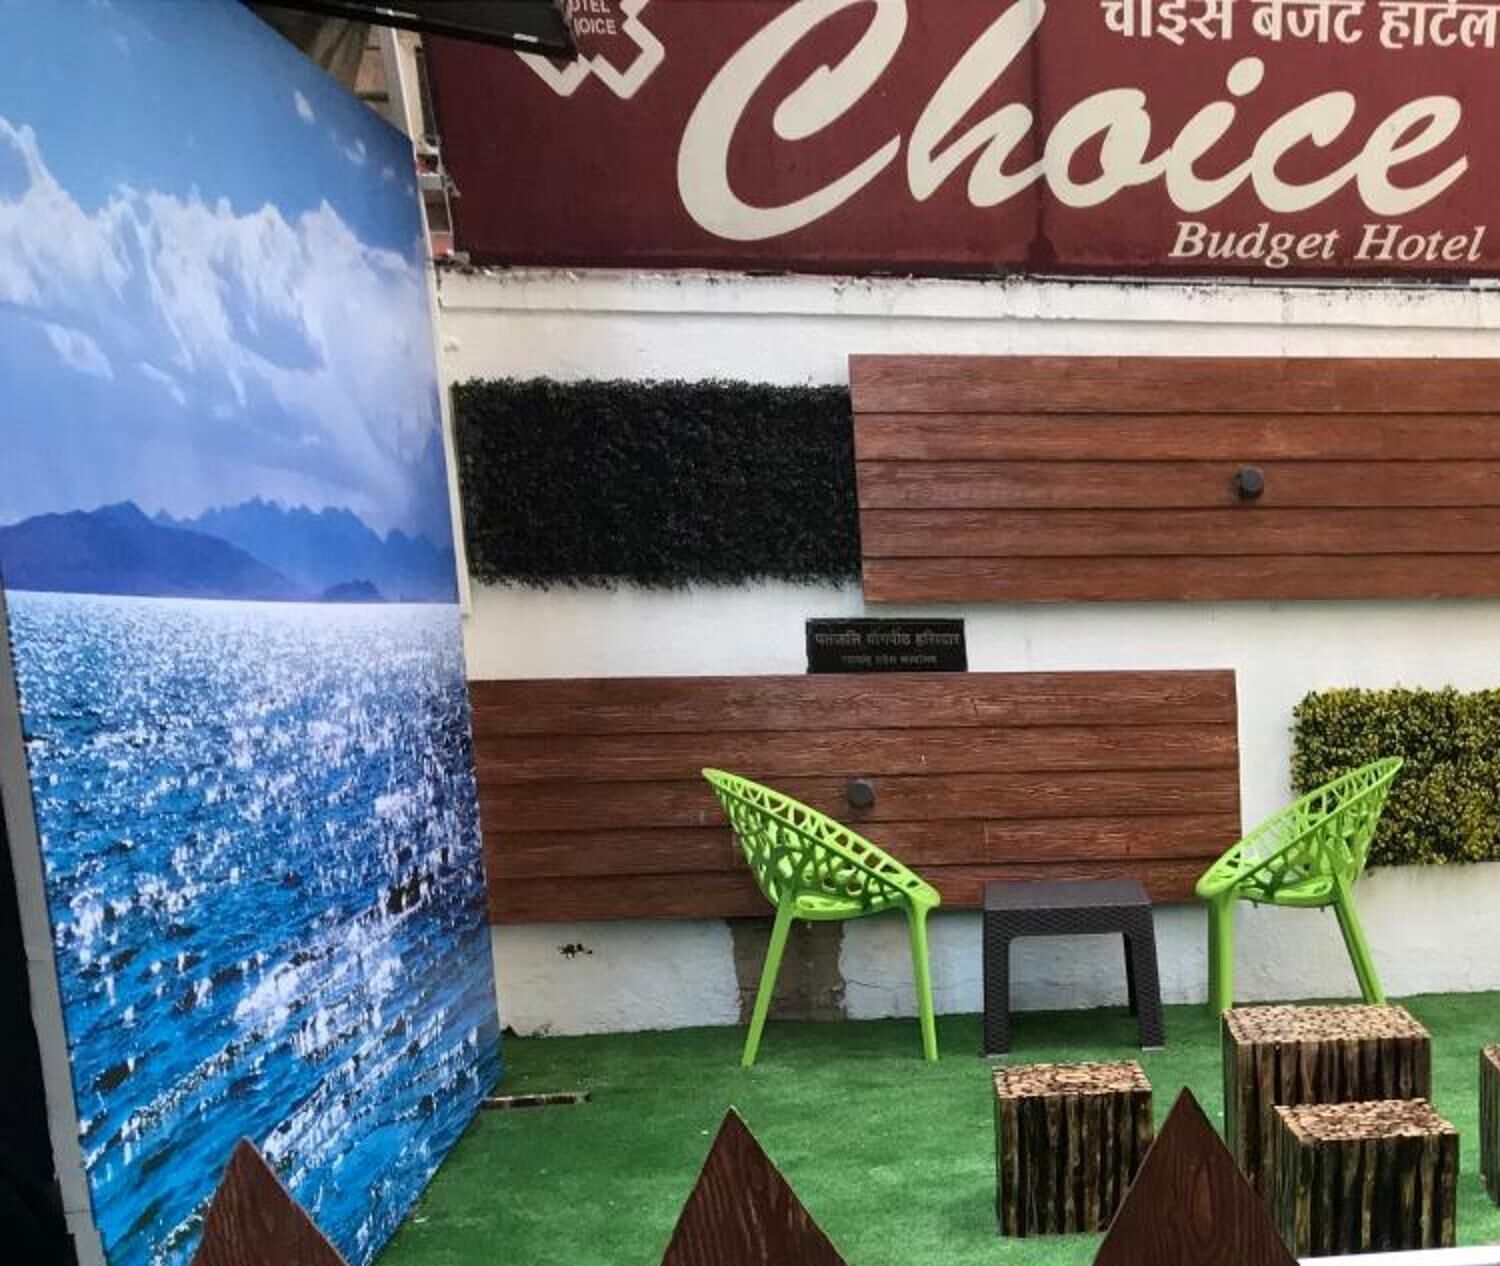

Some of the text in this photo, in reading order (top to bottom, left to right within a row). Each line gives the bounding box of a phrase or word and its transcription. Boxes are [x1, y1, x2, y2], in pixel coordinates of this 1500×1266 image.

[676, 0, 1469, 241] Choice
[1168, 221, 1486, 268] Budget Hotel
